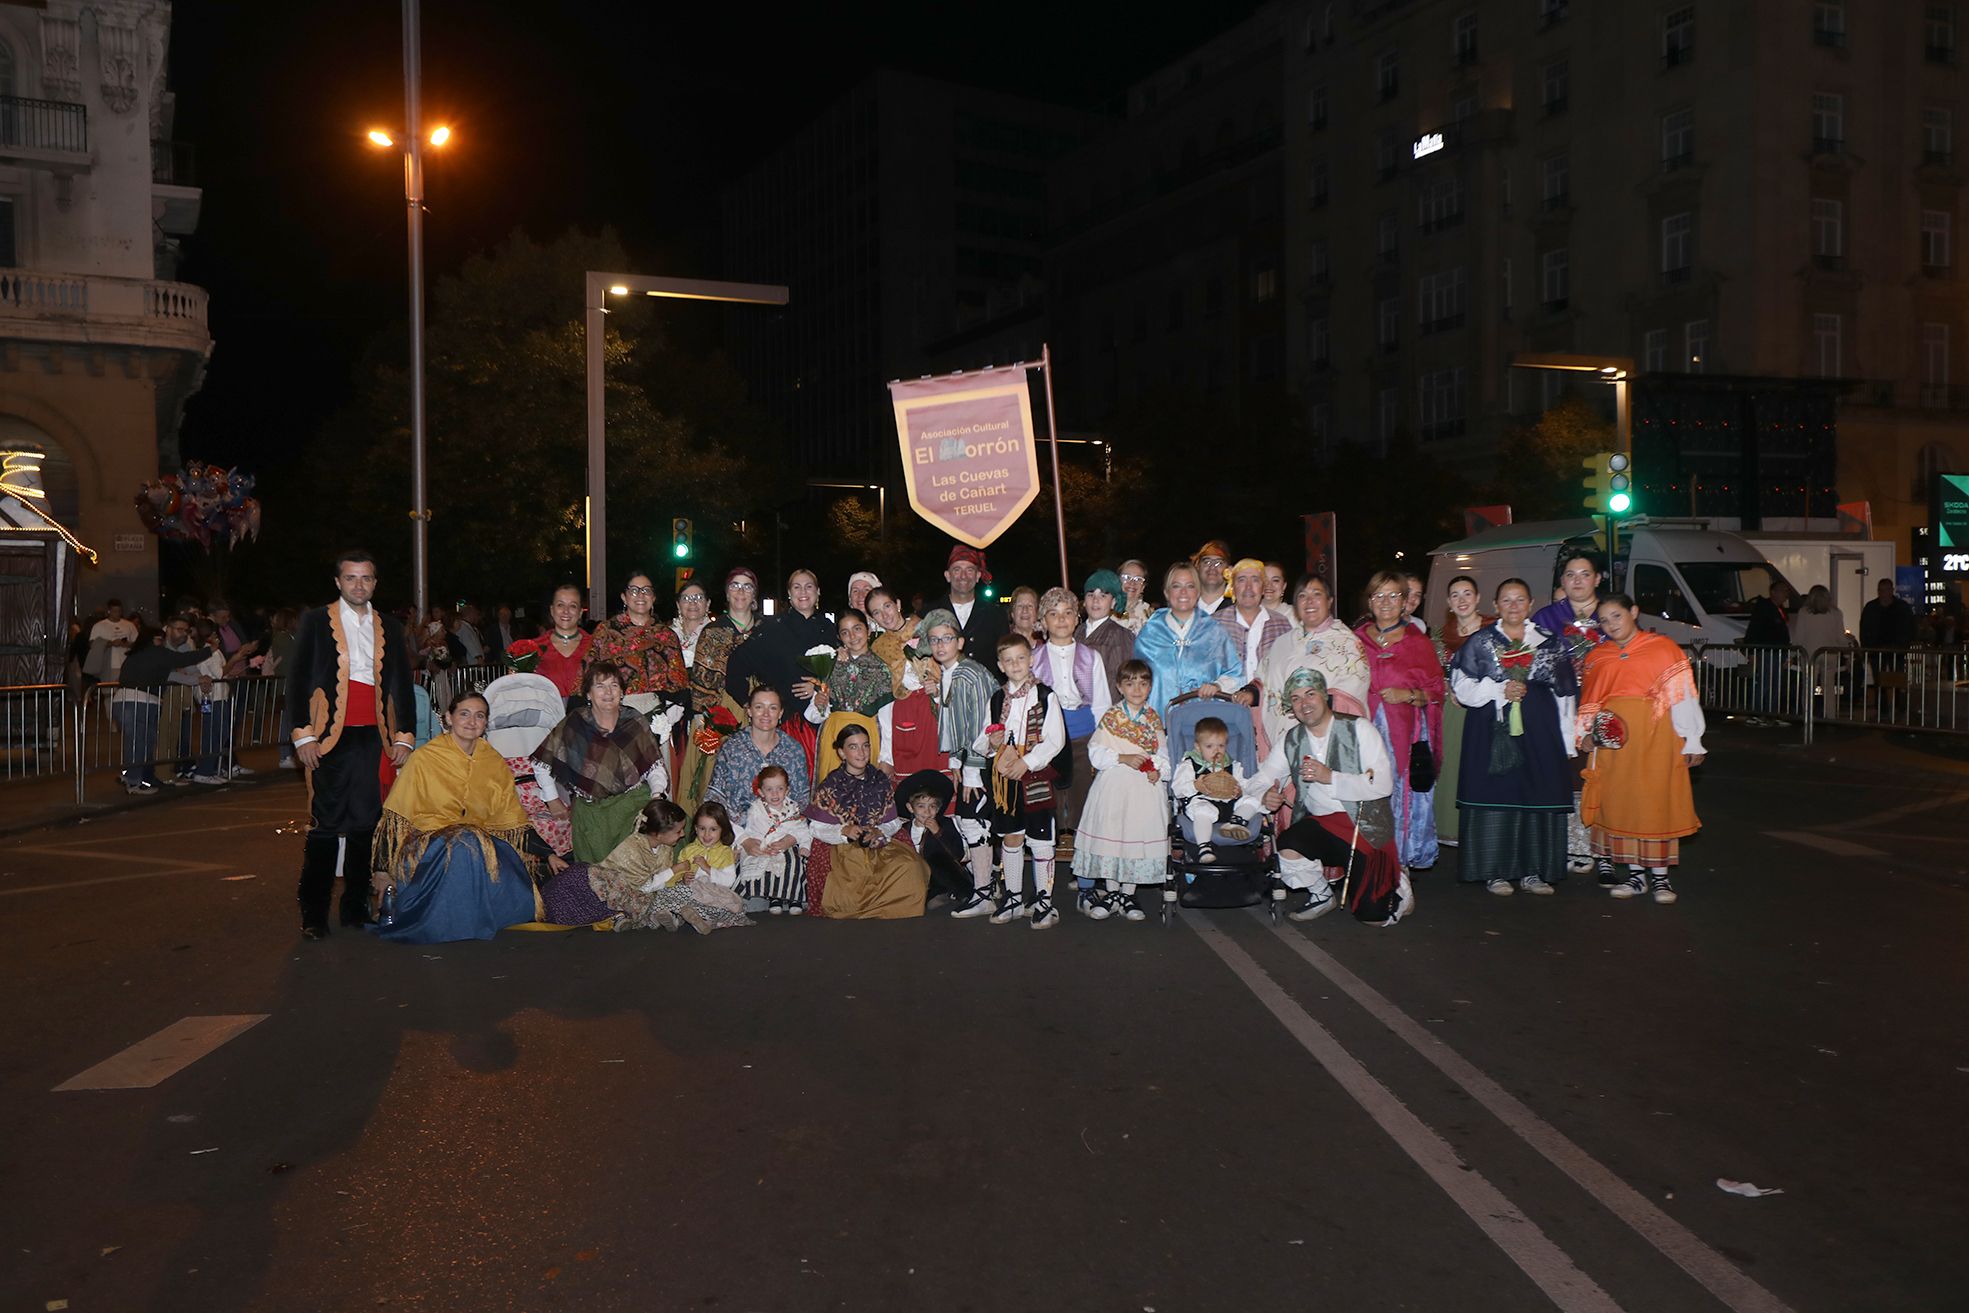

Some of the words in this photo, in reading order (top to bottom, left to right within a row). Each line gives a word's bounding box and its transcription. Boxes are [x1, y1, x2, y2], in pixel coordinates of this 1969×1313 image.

[920, 424, 971, 440] Asociación
[972, 420, 1009, 433] Cultural
[914, 447, 934, 464] El
[931, 475, 957, 488] Las
[959, 468, 1009, 483] Cuevas
[939, 490, 957, 502] de
[959, 482, 1007, 499] Cañart
[953, 502, 997, 516] TERUEL
